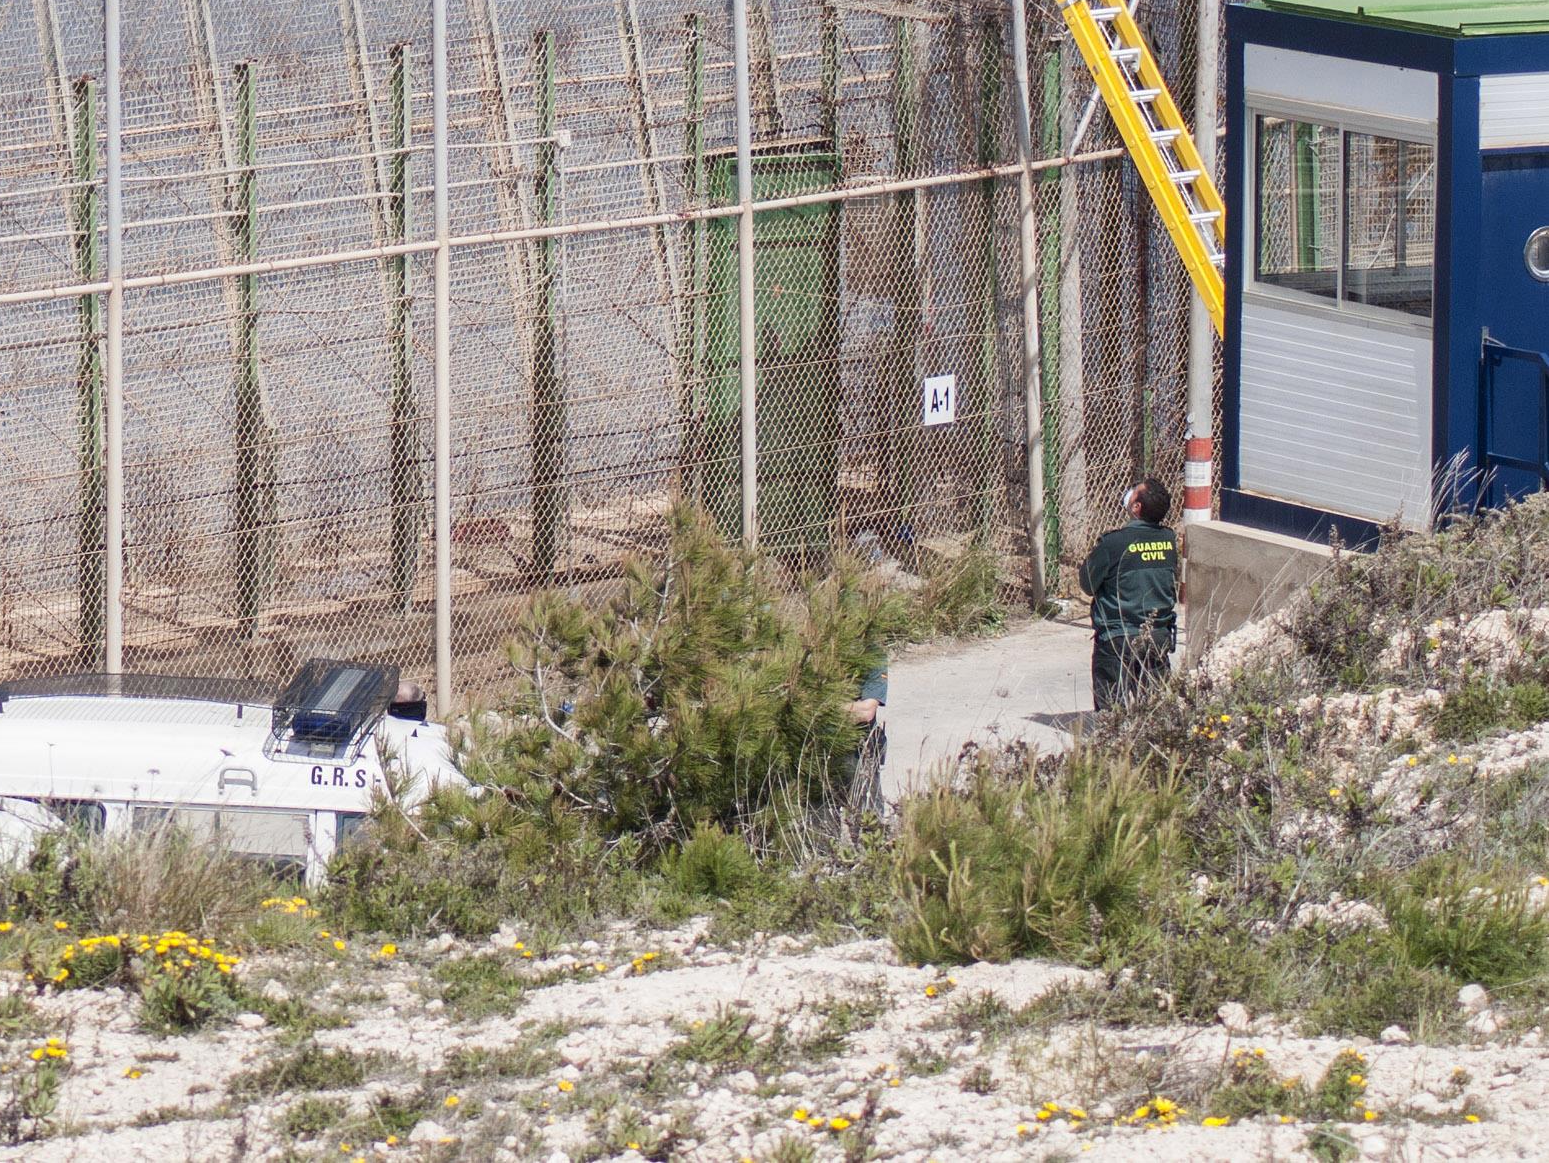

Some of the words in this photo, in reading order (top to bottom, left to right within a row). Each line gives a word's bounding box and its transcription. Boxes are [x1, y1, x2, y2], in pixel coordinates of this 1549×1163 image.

[930, 387, 949, 413] A-1
[1128, 541, 1173, 553] GUARDIA
[1141, 551, 1166, 561] CIVIL
